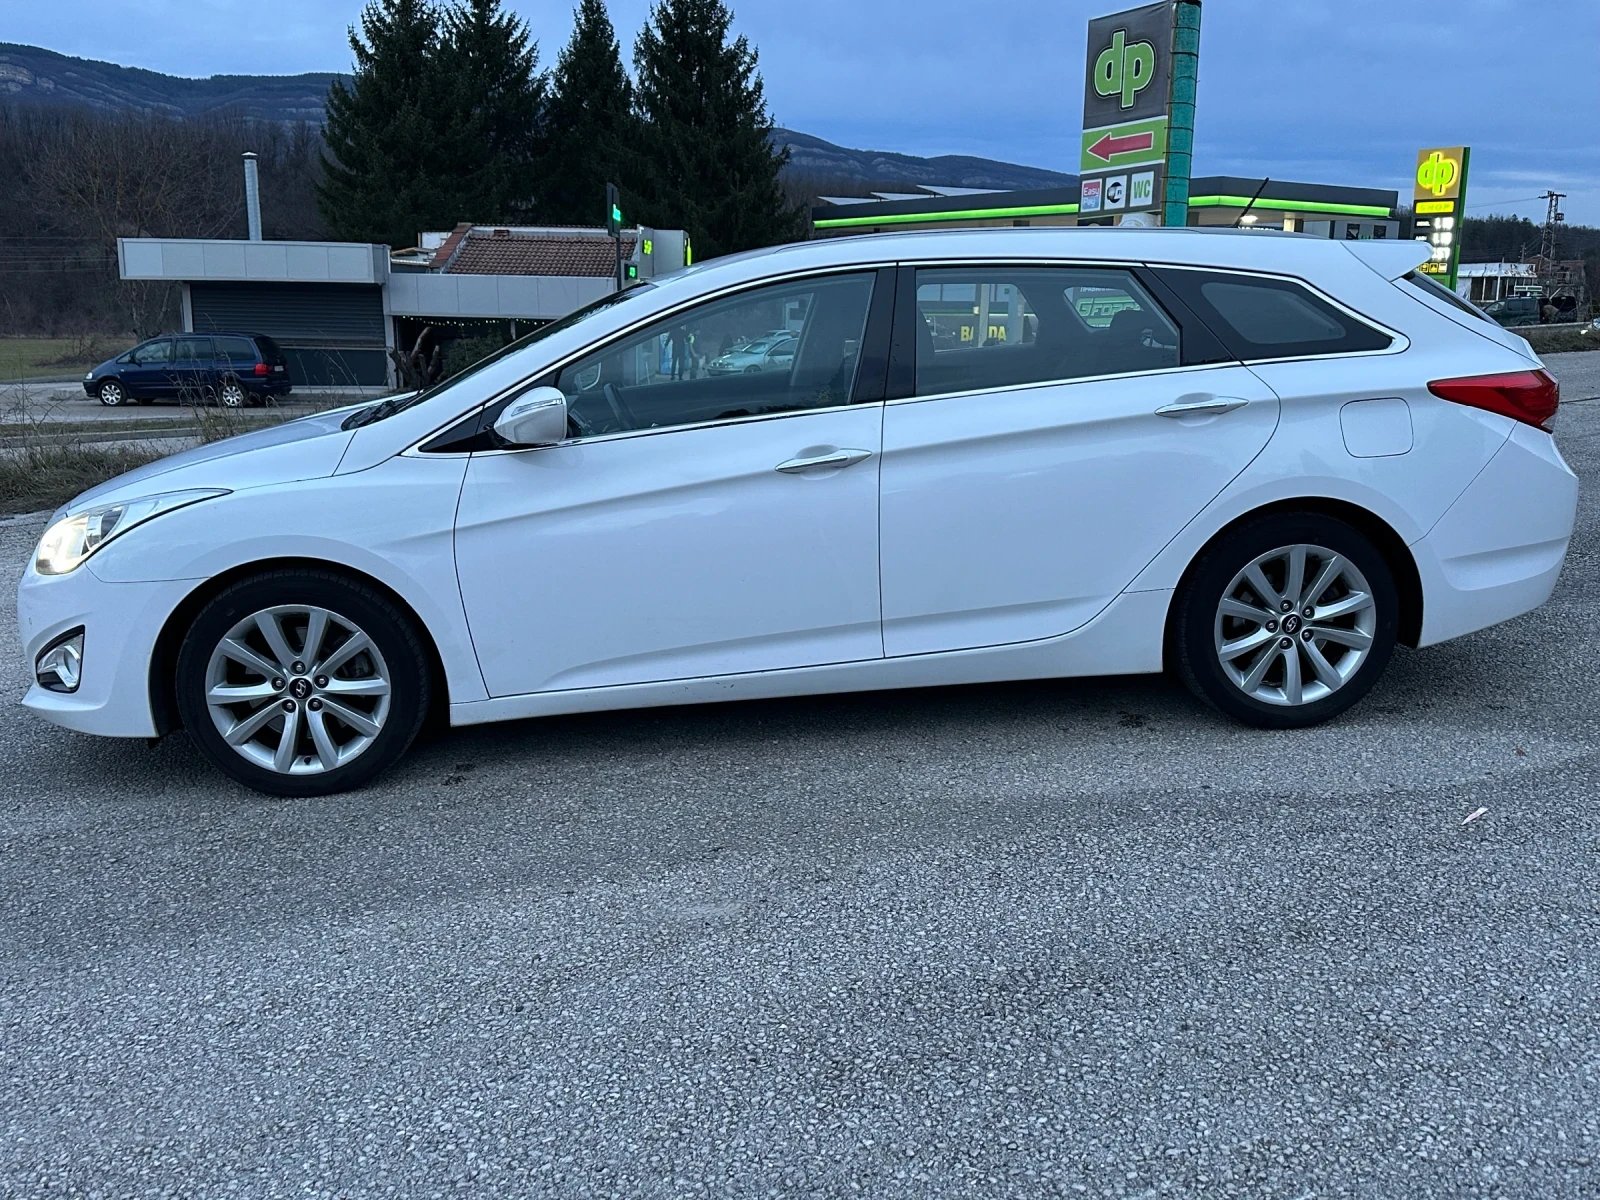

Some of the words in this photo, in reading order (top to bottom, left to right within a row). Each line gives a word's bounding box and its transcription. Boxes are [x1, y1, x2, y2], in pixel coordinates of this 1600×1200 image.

[1094, 29, 1155, 109] dp
[1417, 152, 1457, 195] dp
[1083, 186, 1100, 197] Easy
[1133, 179, 1151, 199] WC
[1420, 203, 1450, 211] SHOP
